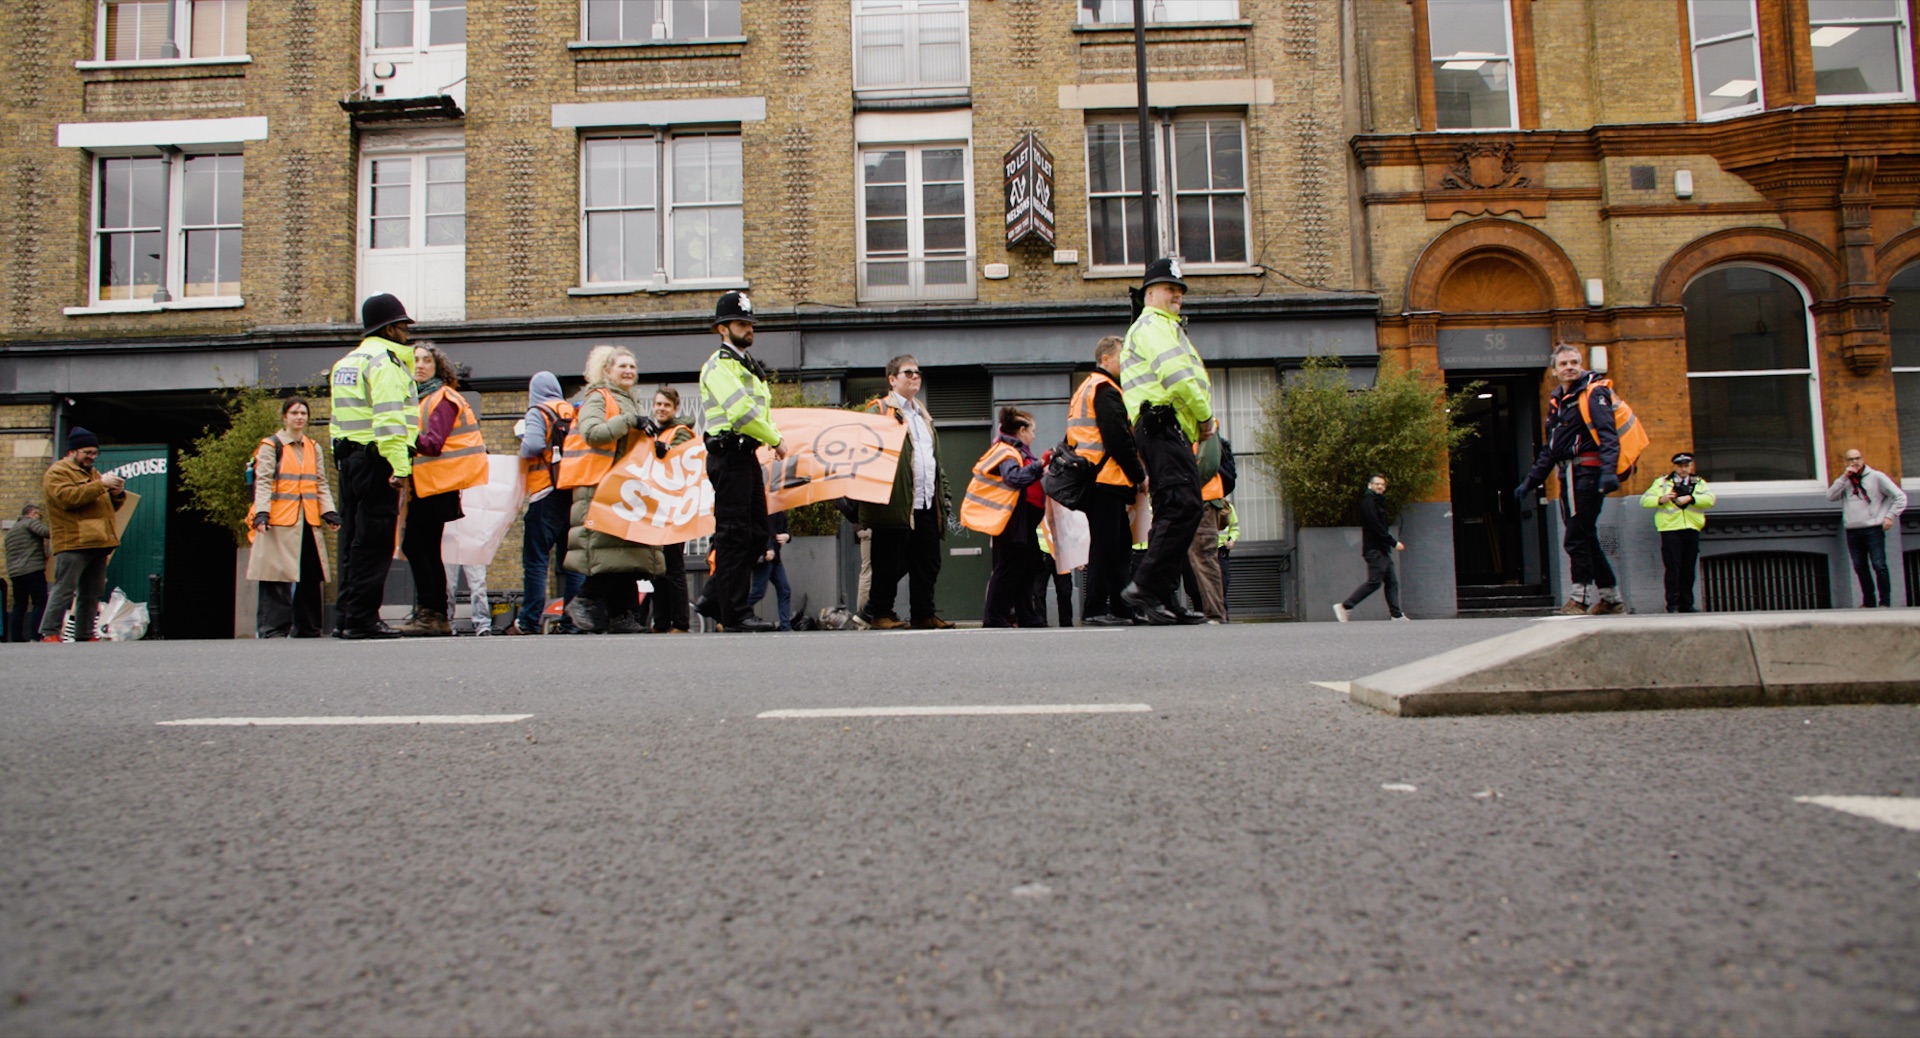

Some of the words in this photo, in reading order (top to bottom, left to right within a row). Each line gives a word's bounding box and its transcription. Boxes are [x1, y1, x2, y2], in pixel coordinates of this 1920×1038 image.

[1006, 160, 1016, 177] TO
[1016, 147, 1029, 169] LET
[1033, 148, 1041, 166] TO
[1041, 156, 1052, 177] LET
[1485, 333, 1506, 350] 58
[624, 443, 706, 491] JUS
[761, 454, 811, 492] IL
